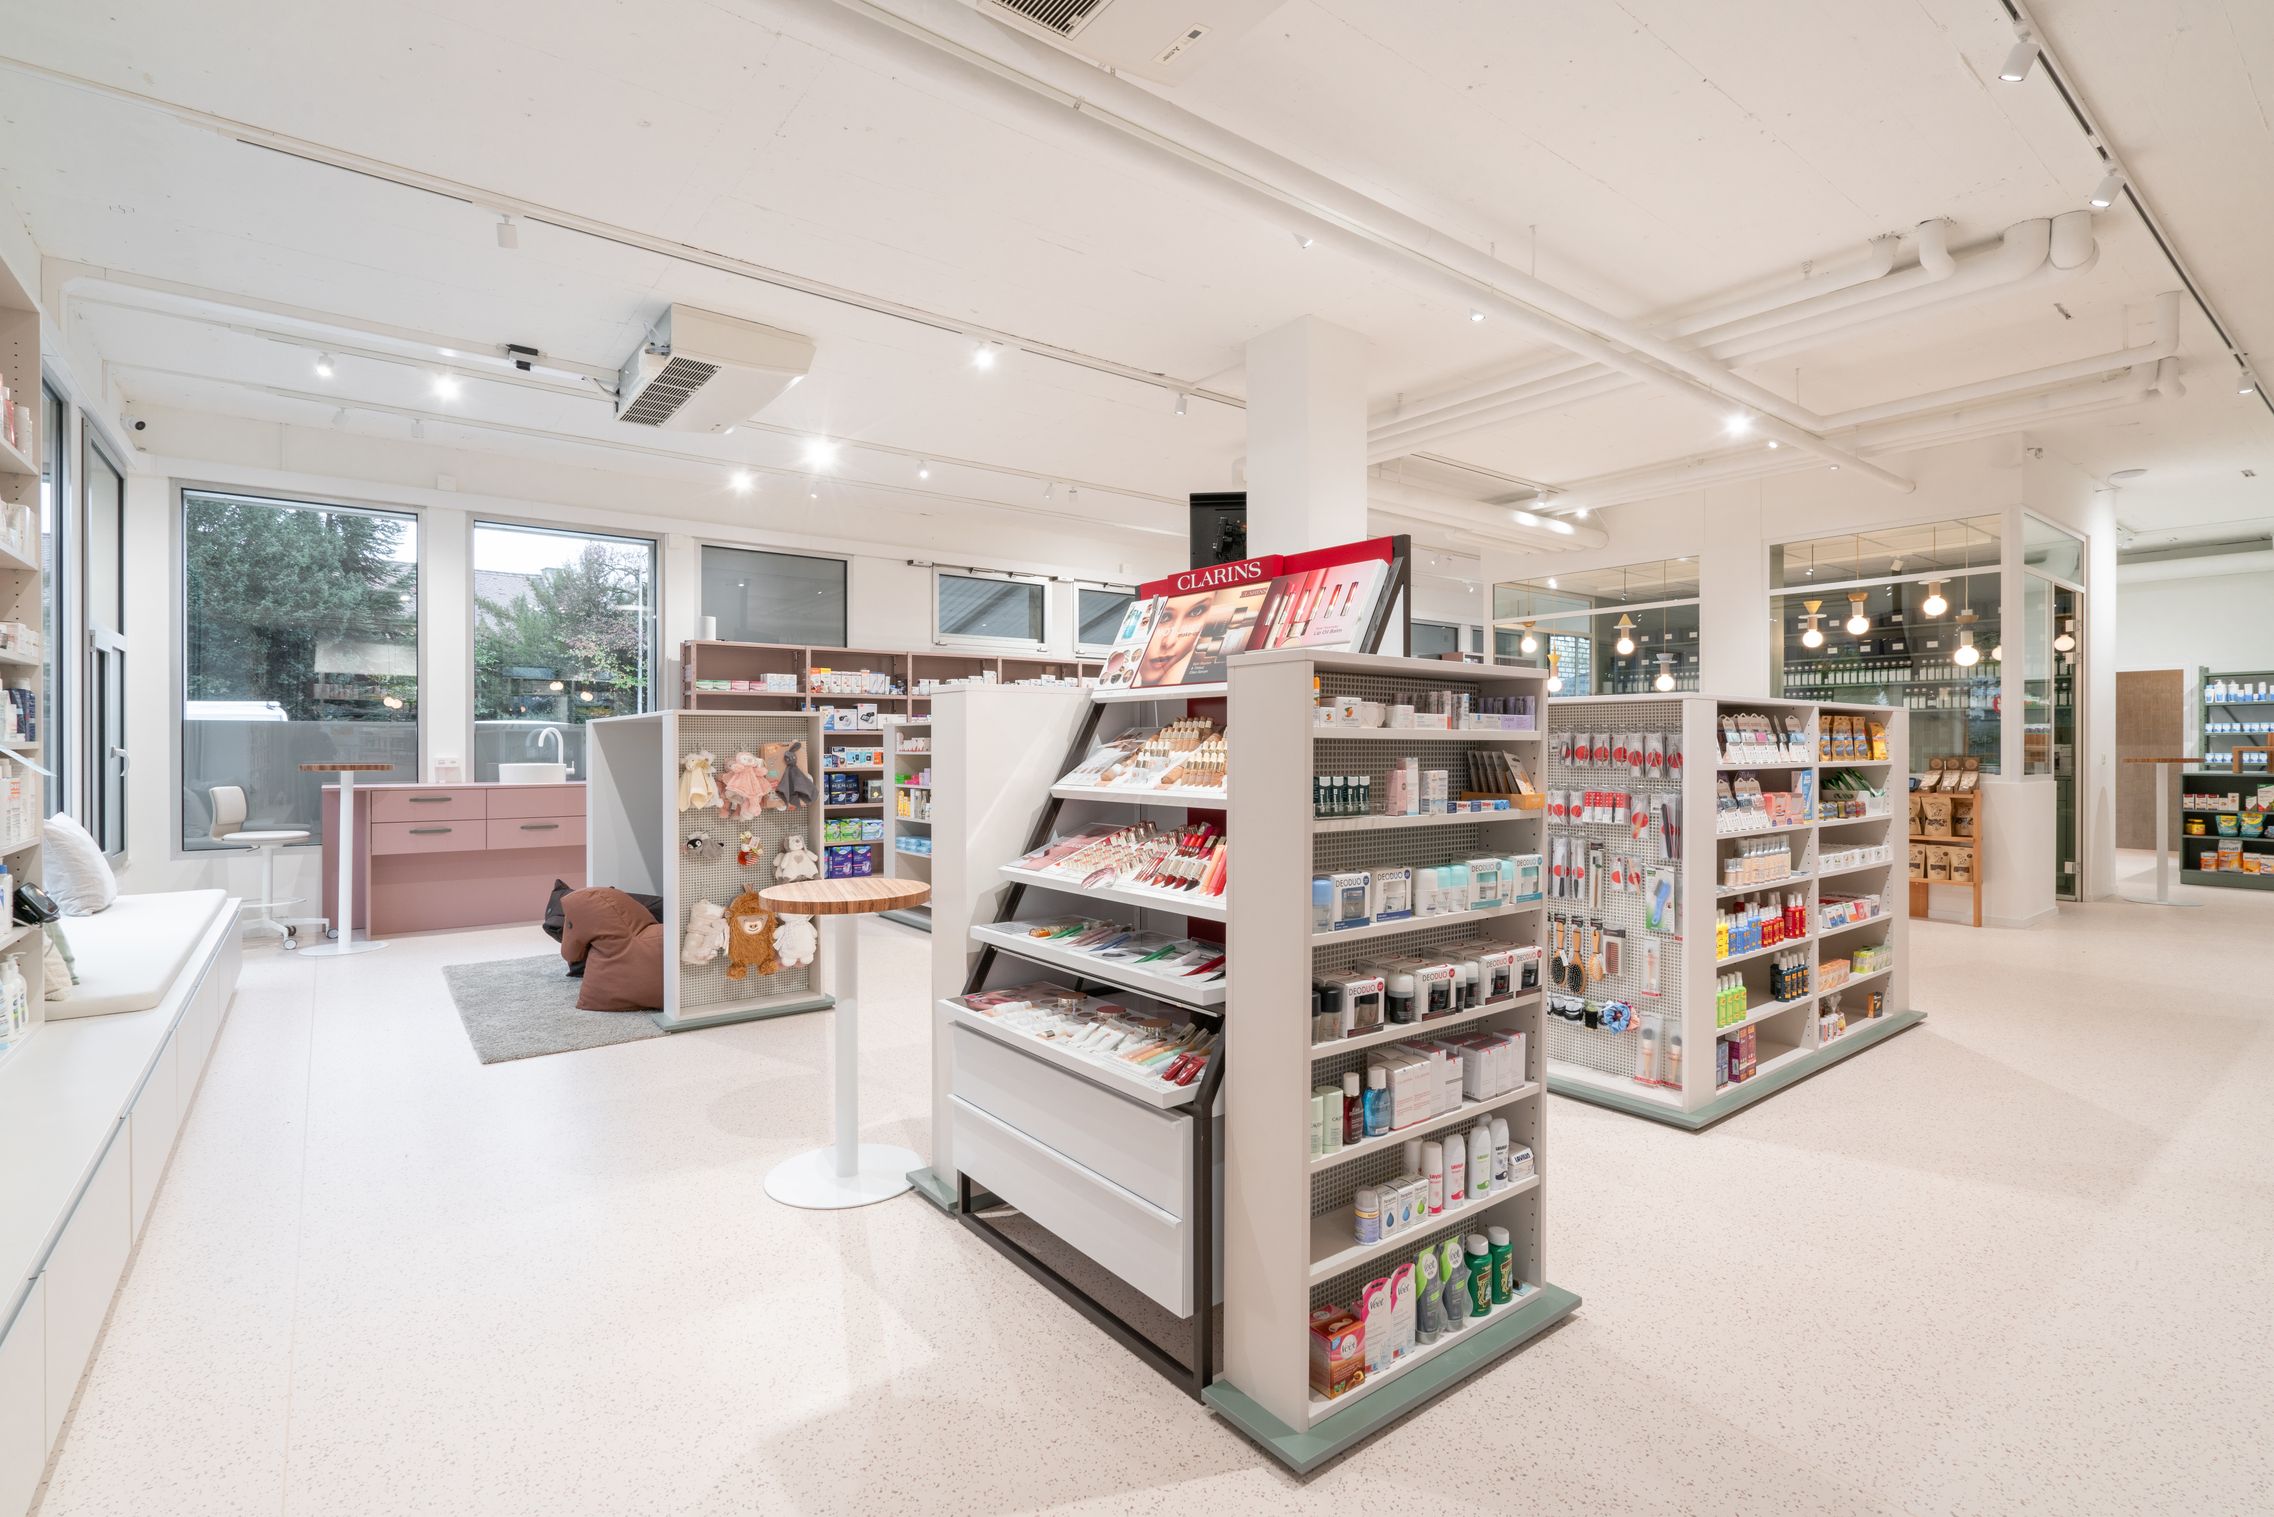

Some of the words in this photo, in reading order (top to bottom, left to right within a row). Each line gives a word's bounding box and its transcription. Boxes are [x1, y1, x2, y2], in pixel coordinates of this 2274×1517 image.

[1177, 561, 1262, 591] CLARINS
[1471, 863, 1495, 873] DEODUO
[1516, 858, 1537, 867] DEODUO
[1377, 871, 1403, 881] DEODUO
[1335, 877, 1362, 888] DEODUO
[1516, 953, 1537, 962] DEODUO
[1486, 959, 1507, 969] DEODUO
[1422, 971, 1447, 982] DEODUO
[1348, 984, 1376, 997] DEODUO
[1397, 1282, 1410, 1296] Veet
[1369, 1297, 1385, 1310] Veet
[1341, 1341, 1357, 1353] Veet
